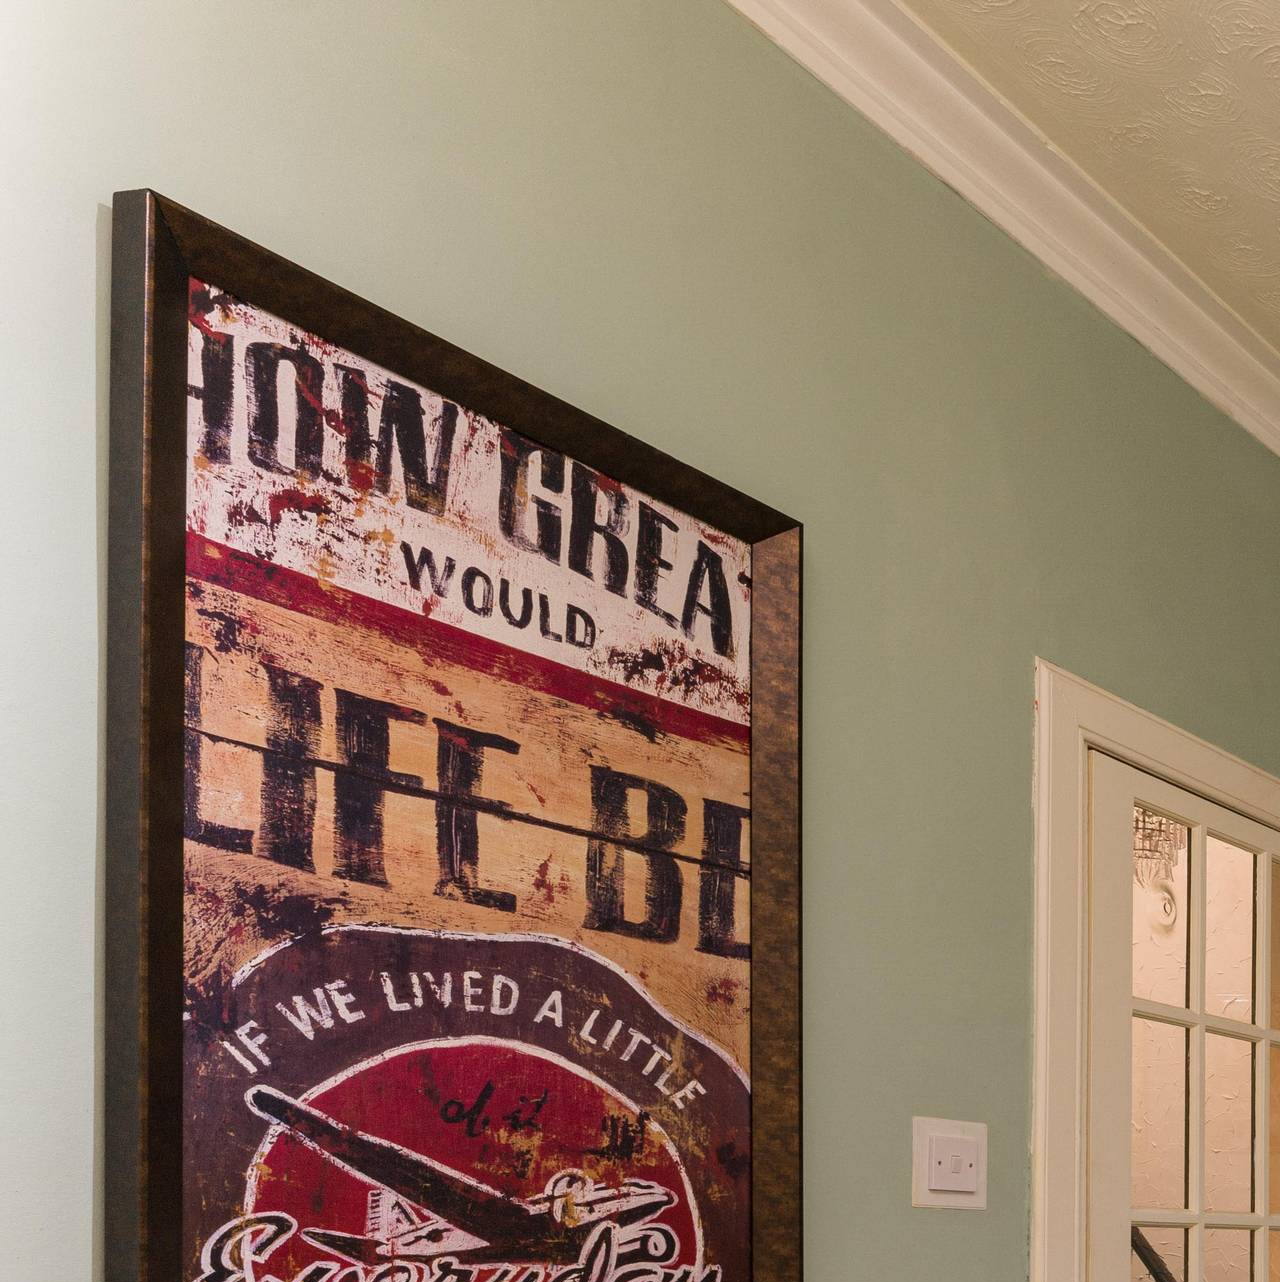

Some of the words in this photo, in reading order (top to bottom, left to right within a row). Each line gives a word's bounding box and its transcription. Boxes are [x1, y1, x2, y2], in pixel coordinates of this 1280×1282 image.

[399, 540, 599, 650] WOULD
[500, 430, 752, 660] GREA
[184, 641, 520, 912] LIFE
[222, 1019, 272, 1074] IF
[275, 979, 366, 1041] WE
[380, 971, 520, 1016] LIVED
[534, 991, 565, 1028] A
[578, 1010, 708, 1111] LITTLE
